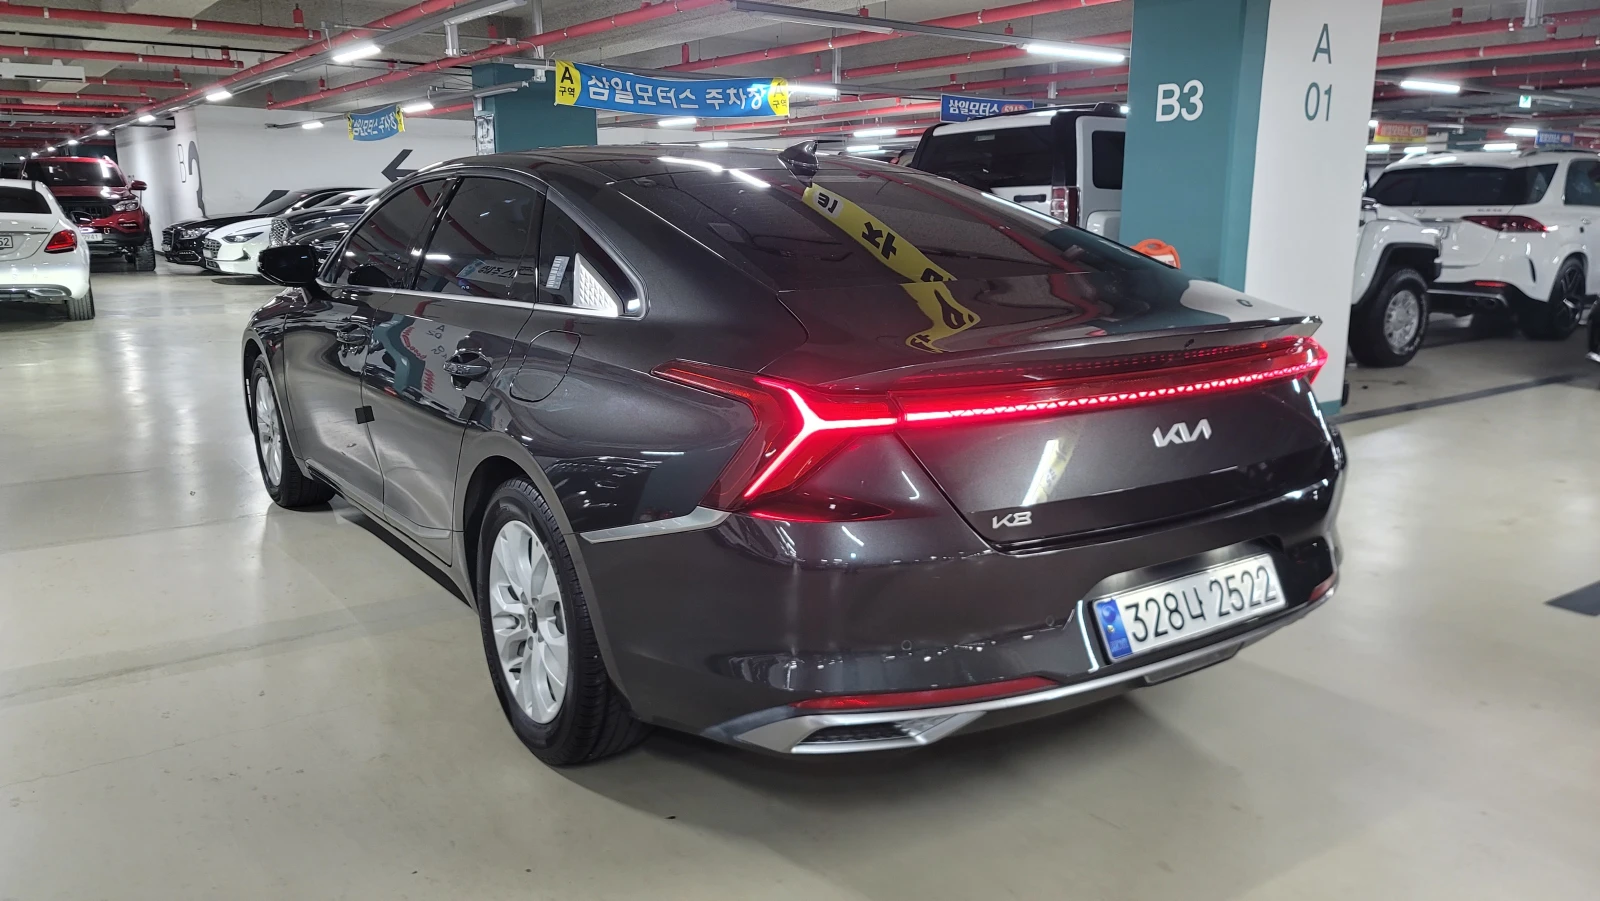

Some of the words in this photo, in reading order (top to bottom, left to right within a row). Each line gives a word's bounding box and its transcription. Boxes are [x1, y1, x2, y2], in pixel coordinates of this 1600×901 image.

[1312, 23, 1332, 65] A
[560, 66, 574, 85] A
[773, 81, 785, 98] A
[558, 86, 576, 98] 구역
[587, 75, 699, 109] 삼일모터스
[705, 87, 767, 110] 주차장
[1155, 79, 1204, 122] B3
[1304, 81, 1332, 122] 01
[948, 99, 999, 117] 삼일모터스
[1153, 418, 1212, 448] KIA
[992, 511, 1033, 529] K8
[1125, 587, 1207, 643] 328나
[1209, 565, 1277, 618] 2522
